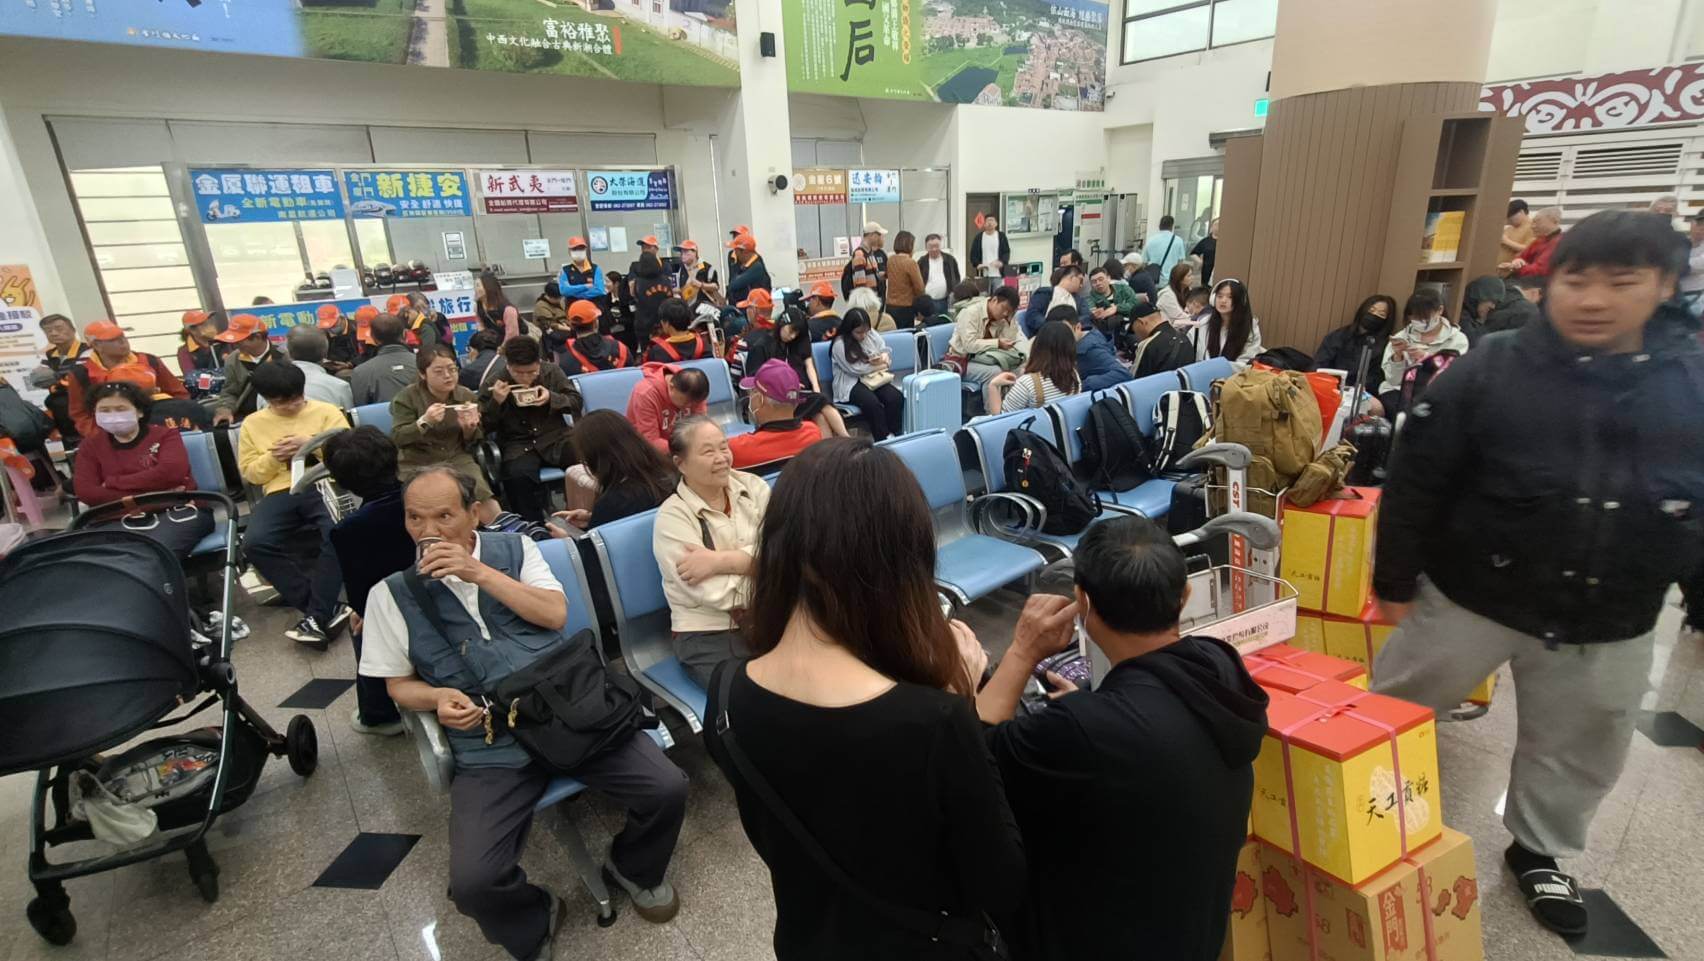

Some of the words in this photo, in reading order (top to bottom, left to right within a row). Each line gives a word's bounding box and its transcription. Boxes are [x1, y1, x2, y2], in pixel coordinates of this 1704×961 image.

[542, 18, 612, 44] 富裕雅聚
[840, 0, 876, 82] 后
[376, 173, 463, 198] 新捷安
[488, 174, 545, 193] 新武夷
[429, 296, 472, 315] 旅行
[1232, 481, 1240, 508] CST
